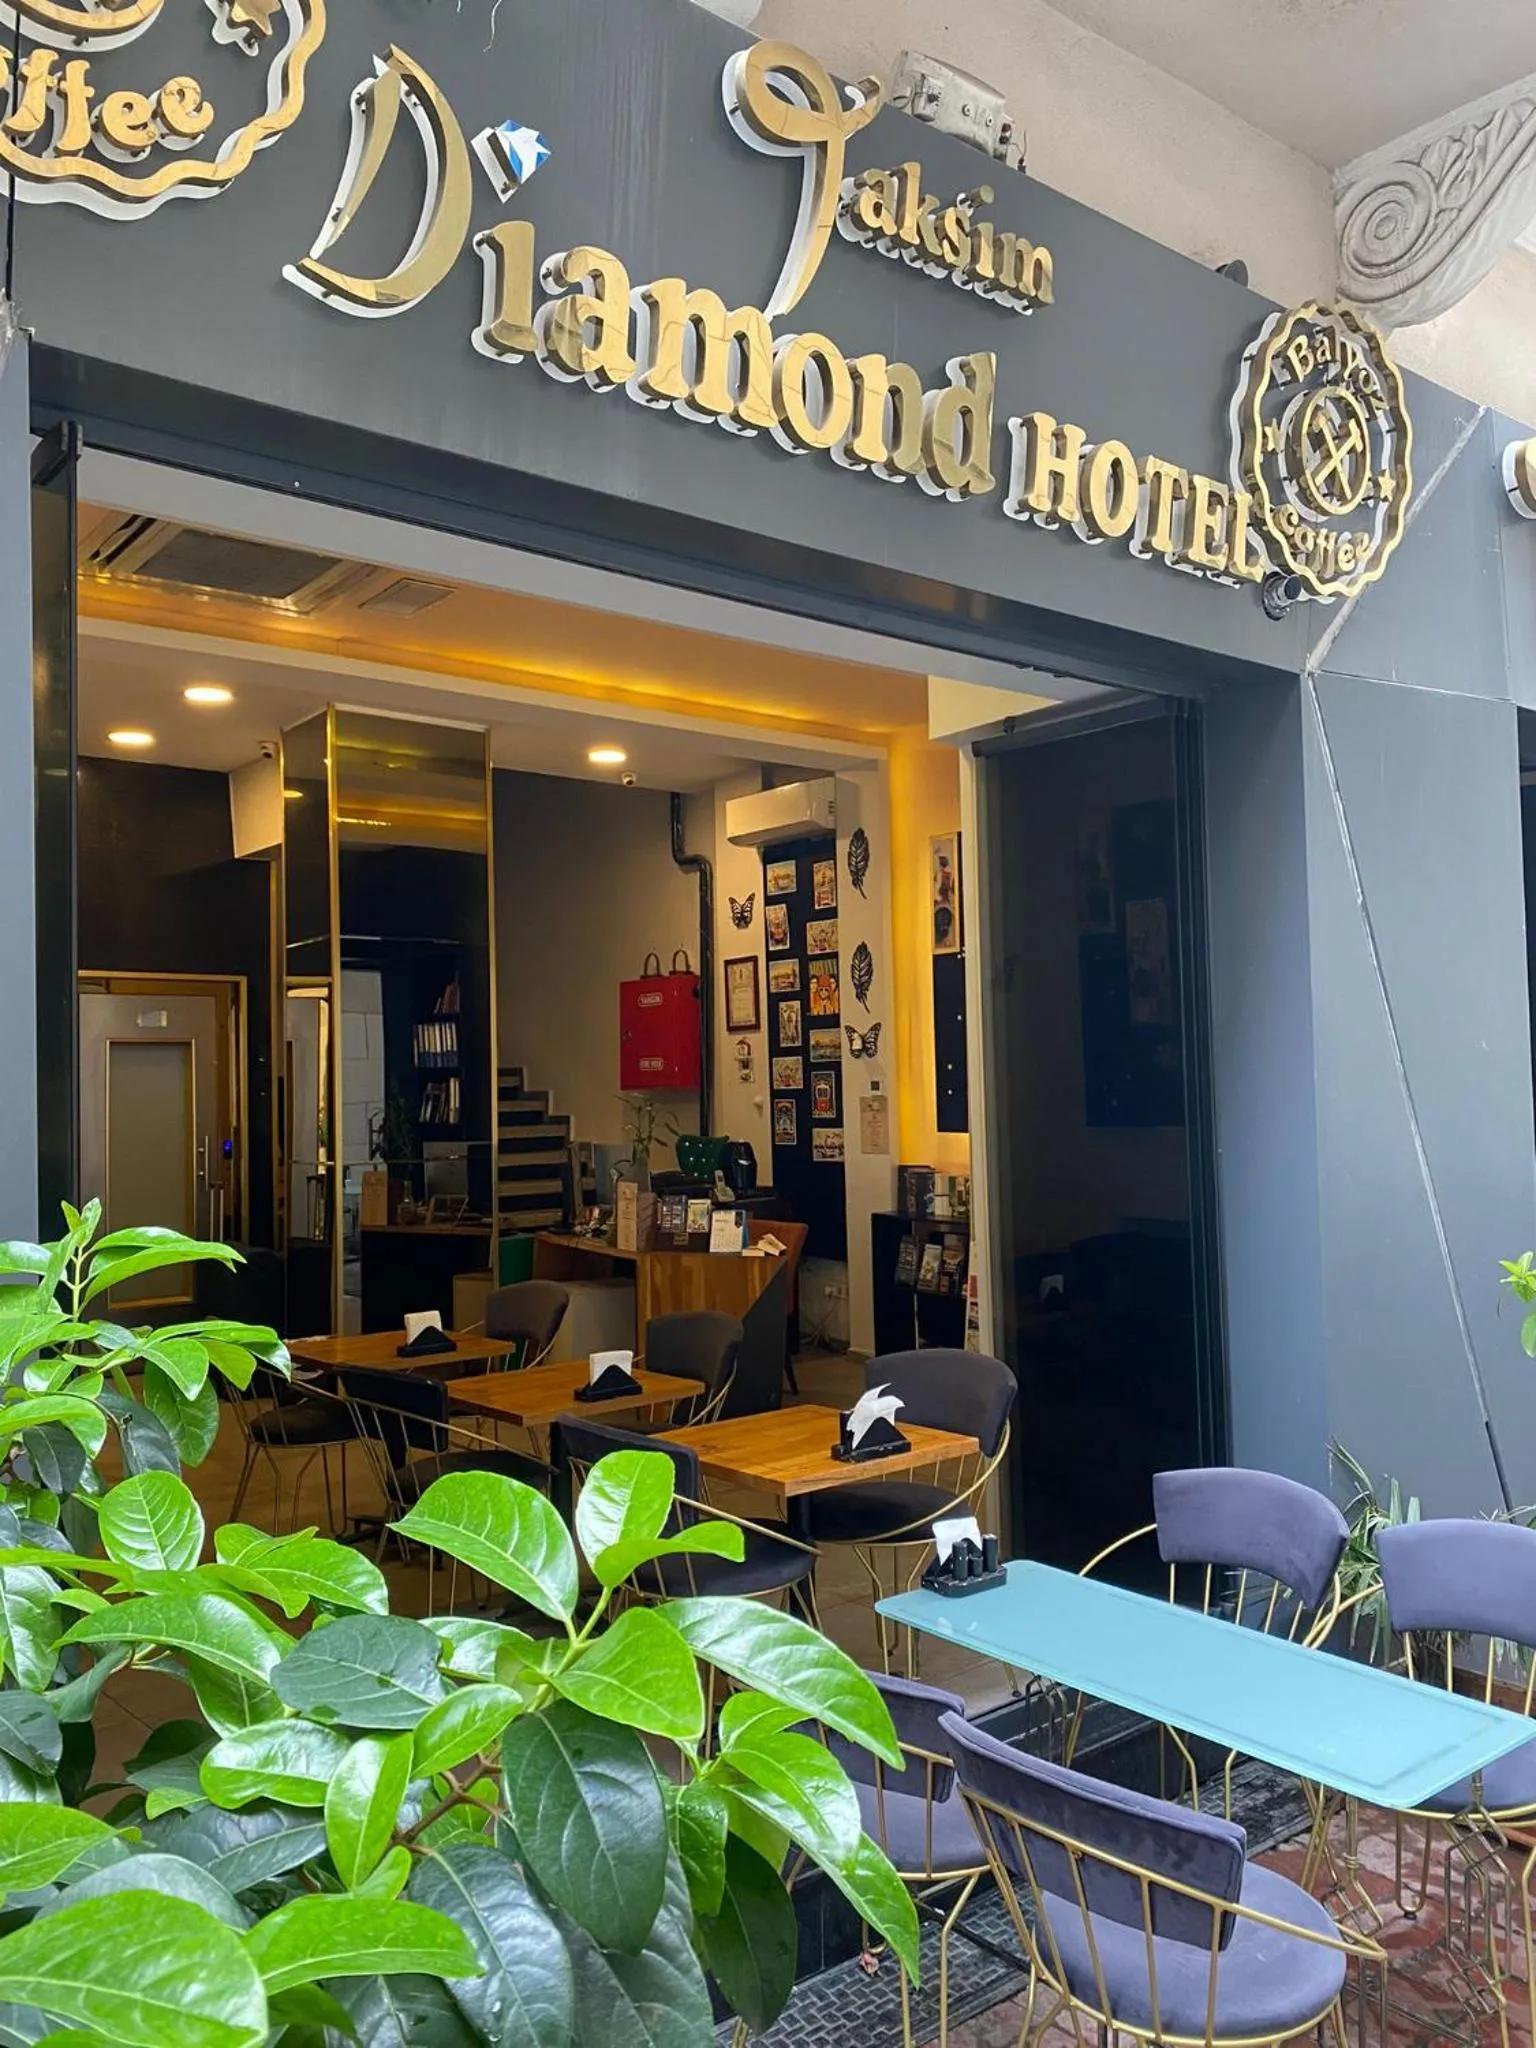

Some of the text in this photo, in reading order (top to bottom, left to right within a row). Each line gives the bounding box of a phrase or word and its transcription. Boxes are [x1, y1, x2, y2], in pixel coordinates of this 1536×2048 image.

[0, 45, 214, 158] ffee
[723, 40, 1054, 316] Taksim
[284, 44, 1264, 585] Diamond HOTEL
[1274, 503, 1371, 580] Coffee
